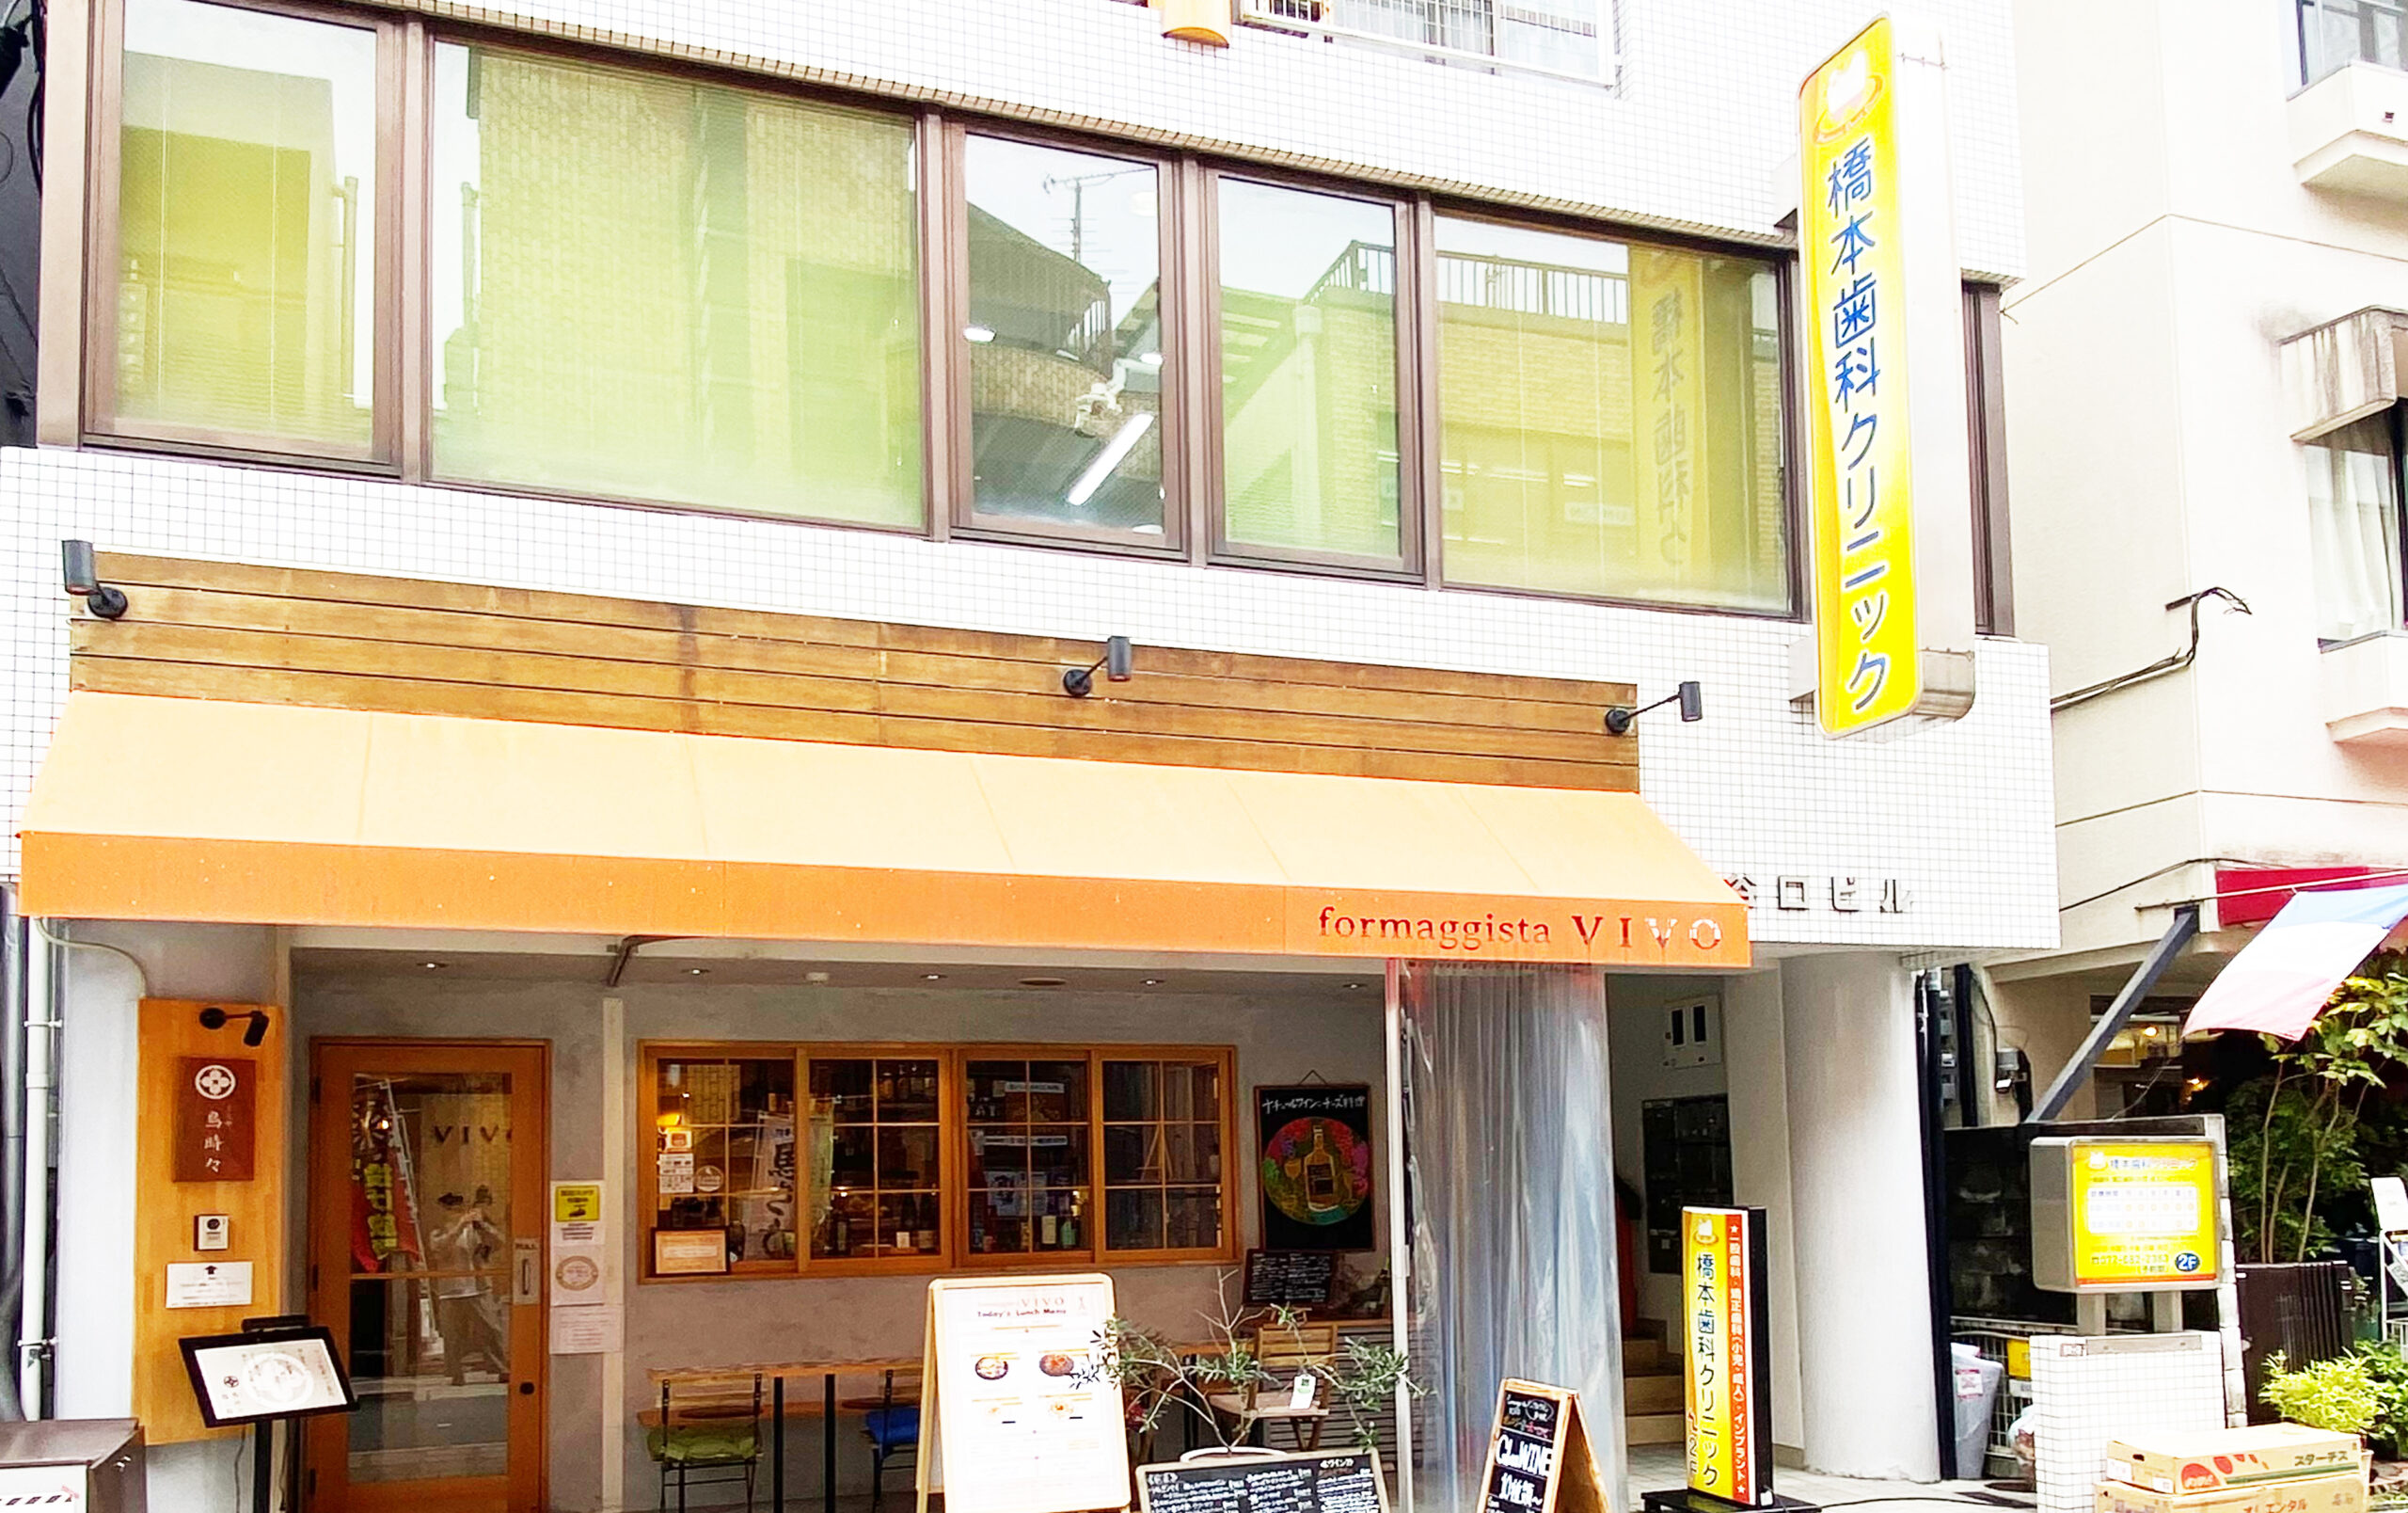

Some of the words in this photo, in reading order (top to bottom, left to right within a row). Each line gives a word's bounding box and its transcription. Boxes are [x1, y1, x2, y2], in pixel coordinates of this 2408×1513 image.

[1828, 137, 1886, 710] 橋本歯科クリニック
[1319, 906, 1551, 950] formaggista
[1571, 916, 1722, 950] VIVO
[434, 1124, 513, 1144] VIV
[2177, 1253, 2197, 1270] 2F
[1697, 1253, 1719, 1486] 橋本歯科クリニック
[2294, 1450, 2349, 1467] スターチス
